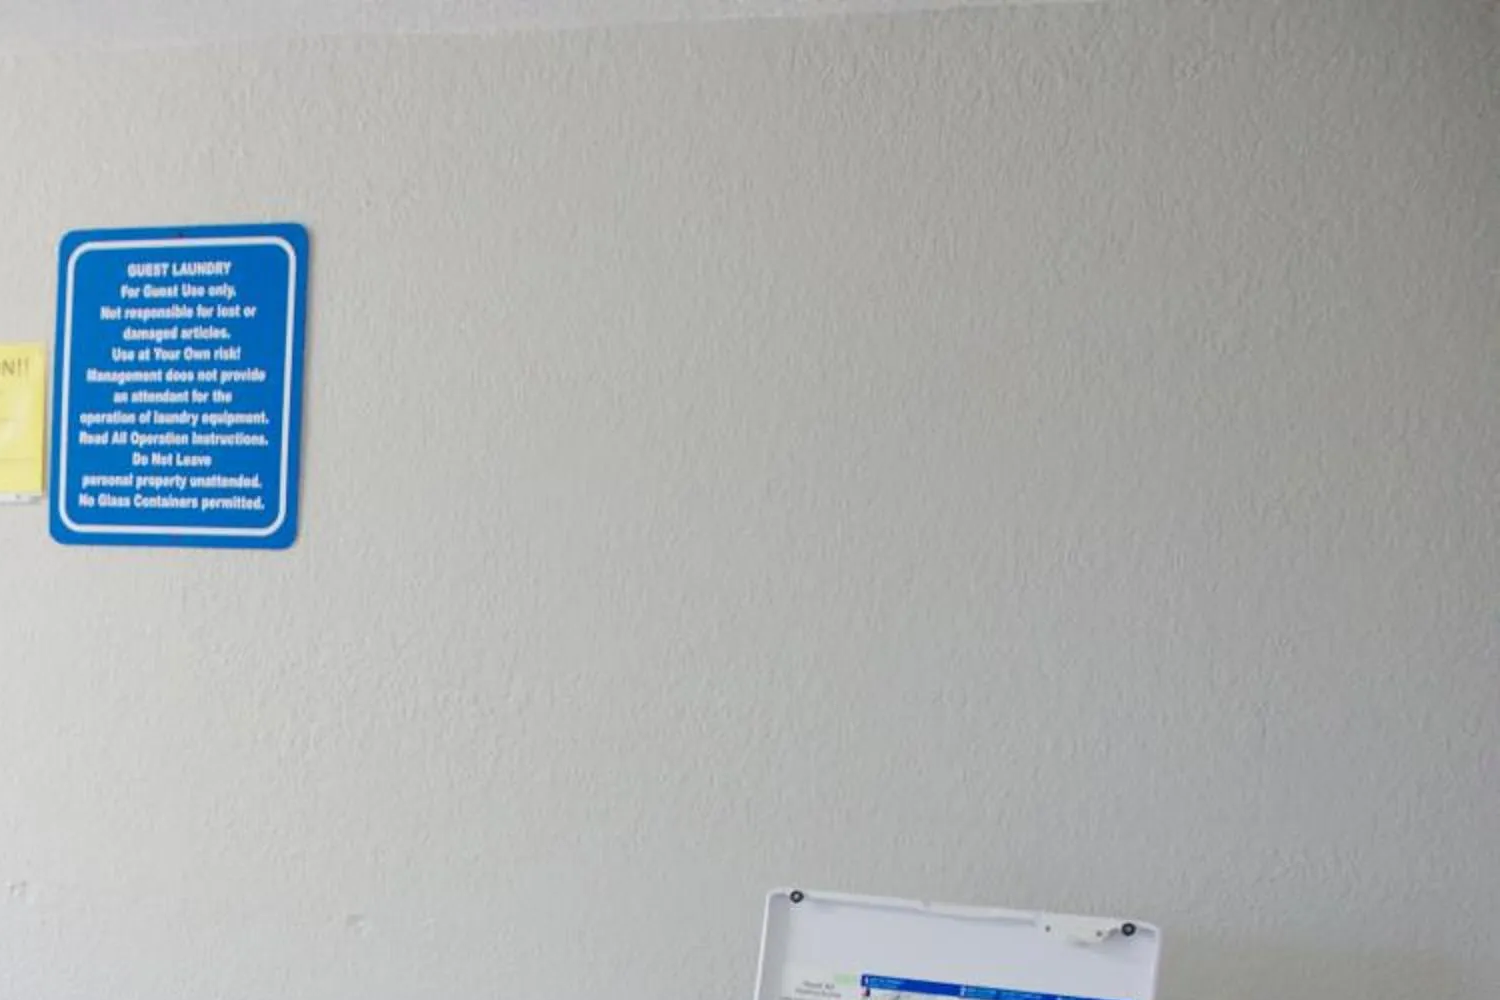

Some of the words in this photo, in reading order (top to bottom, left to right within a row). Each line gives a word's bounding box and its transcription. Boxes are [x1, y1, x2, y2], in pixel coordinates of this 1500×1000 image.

[127, 263, 169, 278] GUEST
[172, 261, 232, 276] LAUNDRY
[121, 285, 140, 298] For
[144, 284, 178, 298] Guest
[182, 284, 205, 297] Use
[208, 283, 236, 300] only.
[101, 306, 121, 320] Not
[124, 305, 193, 322] responsible
[196, 304, 214, 318] for
[217, 304, 240, 318] lost
[244, 306, 256, 317] or
[123, 327, 178, 343] damaged
[181, 326, 231, 340] articles.
[111, 348, 134, 362] Use
[138, 348, 150, 361] at
[154, 348, 180, 360] Your
[184, 348, 210, 360] Own
[214, 347, 241, 360] risk!
[86, 369, 162, 385] Management
[165, 368, 194, 382] does
[197, 369, 218, 382] not
[220, 368, 266, 384] provide
[113, 391, 128, 403] an
[131, 390, 189, 403] attendant
[192, 390, 208, 403] for
[212, 390, 233, 403] the
[80, 411, 135, 427] operation
[139, 411, 152, 424] of
[154, 411, 199, 427] laundry
[202, 411, 270, 427] equipment.
[79, 432, 109, 445] Read
[111, 432, 127, 445] All
[130, 432, 188, 447] Operation
[192, 432, 269, 446] Instructions.
[132, 453, 148, 466] Do
[152, 453, 173, 466] Not
[176, 453, 212, 466] Leave
[81, 474, 133, 489] personal
[136, 474, 187, 489] property
[190, 474, 262, 489] unattended.
[79, 494, 94, 507] No
[98, 494, 130, 508] Glass
[134, 495, 198, 508] Containers
[202, 496, 265, 511] permitted.
